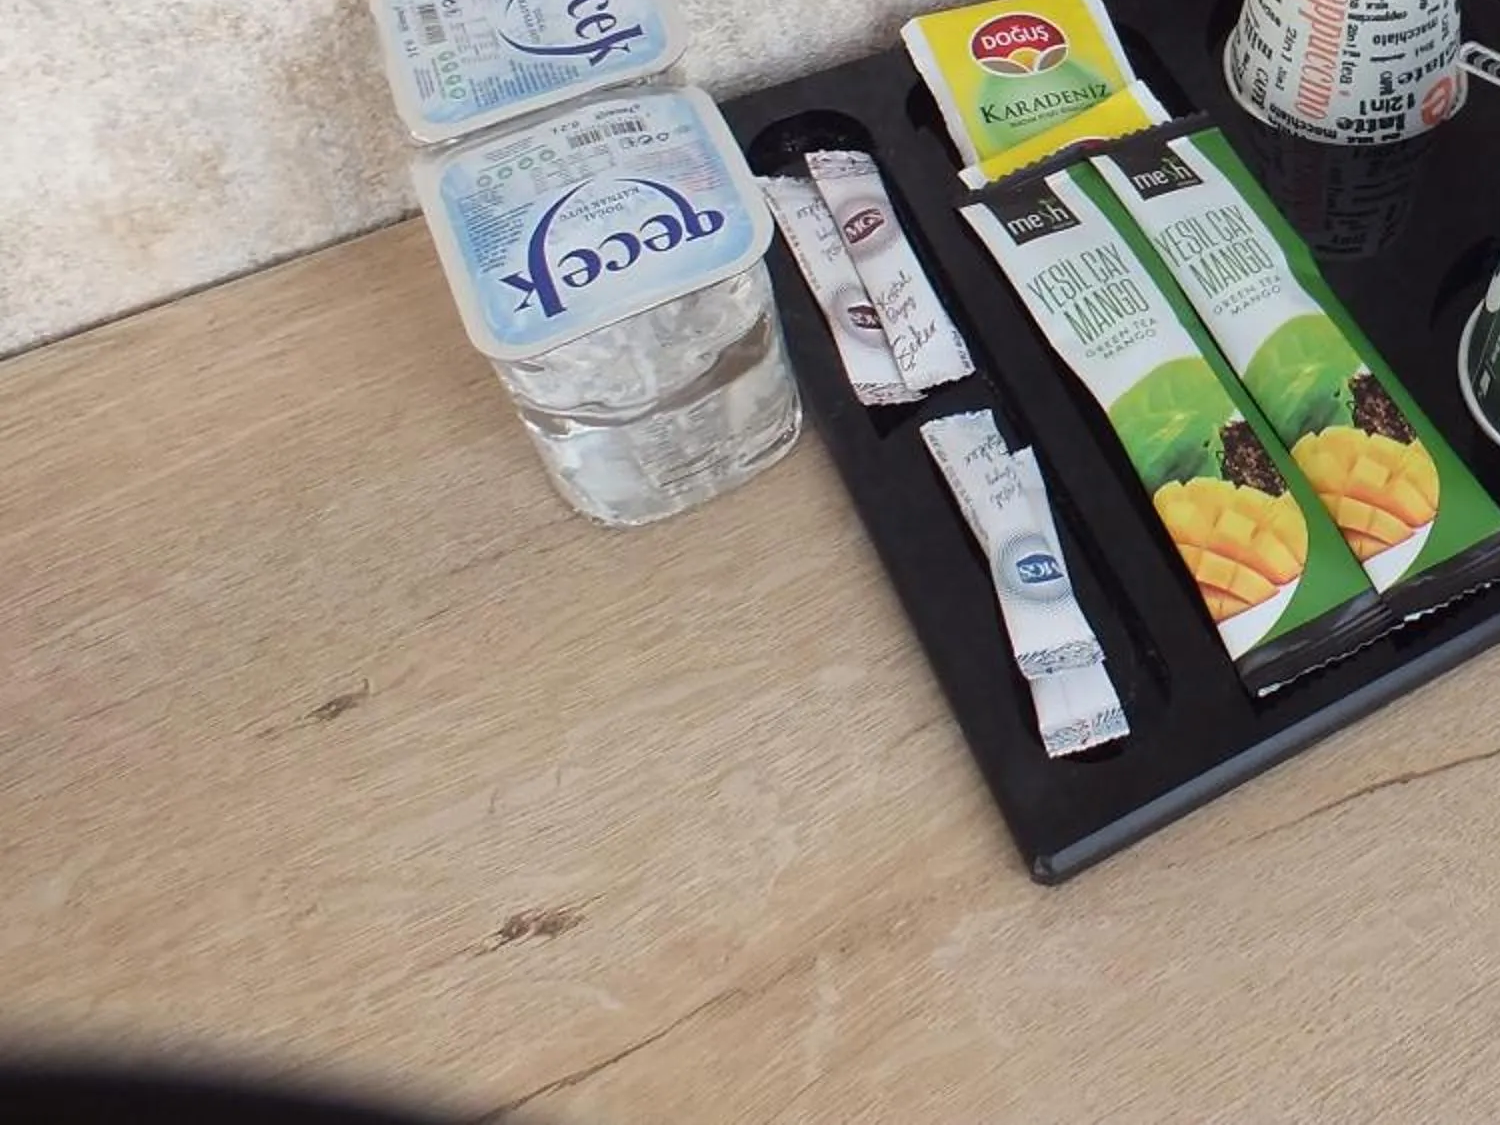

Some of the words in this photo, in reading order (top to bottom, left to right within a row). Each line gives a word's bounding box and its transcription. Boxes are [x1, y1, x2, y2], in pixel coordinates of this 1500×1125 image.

[980, 24, 1051, 51] DOĞUŞ
[1188, 236, 1275, 300] MANGO
[1063, 277, 1150, 347] MANGO
